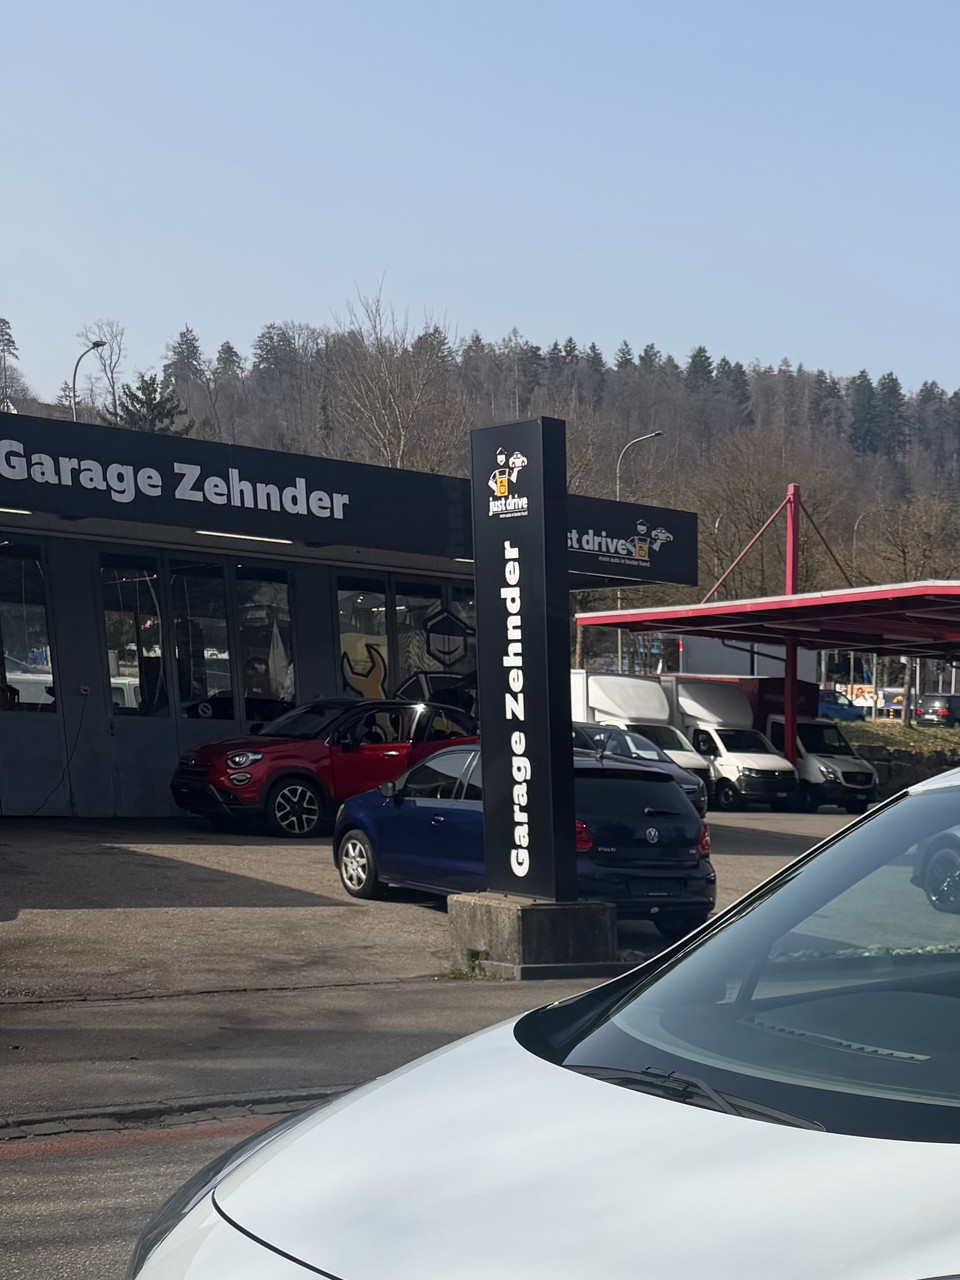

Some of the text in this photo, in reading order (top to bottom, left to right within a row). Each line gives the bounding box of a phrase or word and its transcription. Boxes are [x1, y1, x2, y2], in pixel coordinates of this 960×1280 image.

[0, 439, 350, 520] Garage Zehnder
[489, 494, 528, 516] just drive
[581, 529, 628, 555] drive
[500, 540, 525, 721] Zehnder
[510, 731, 532, 878] Garage
